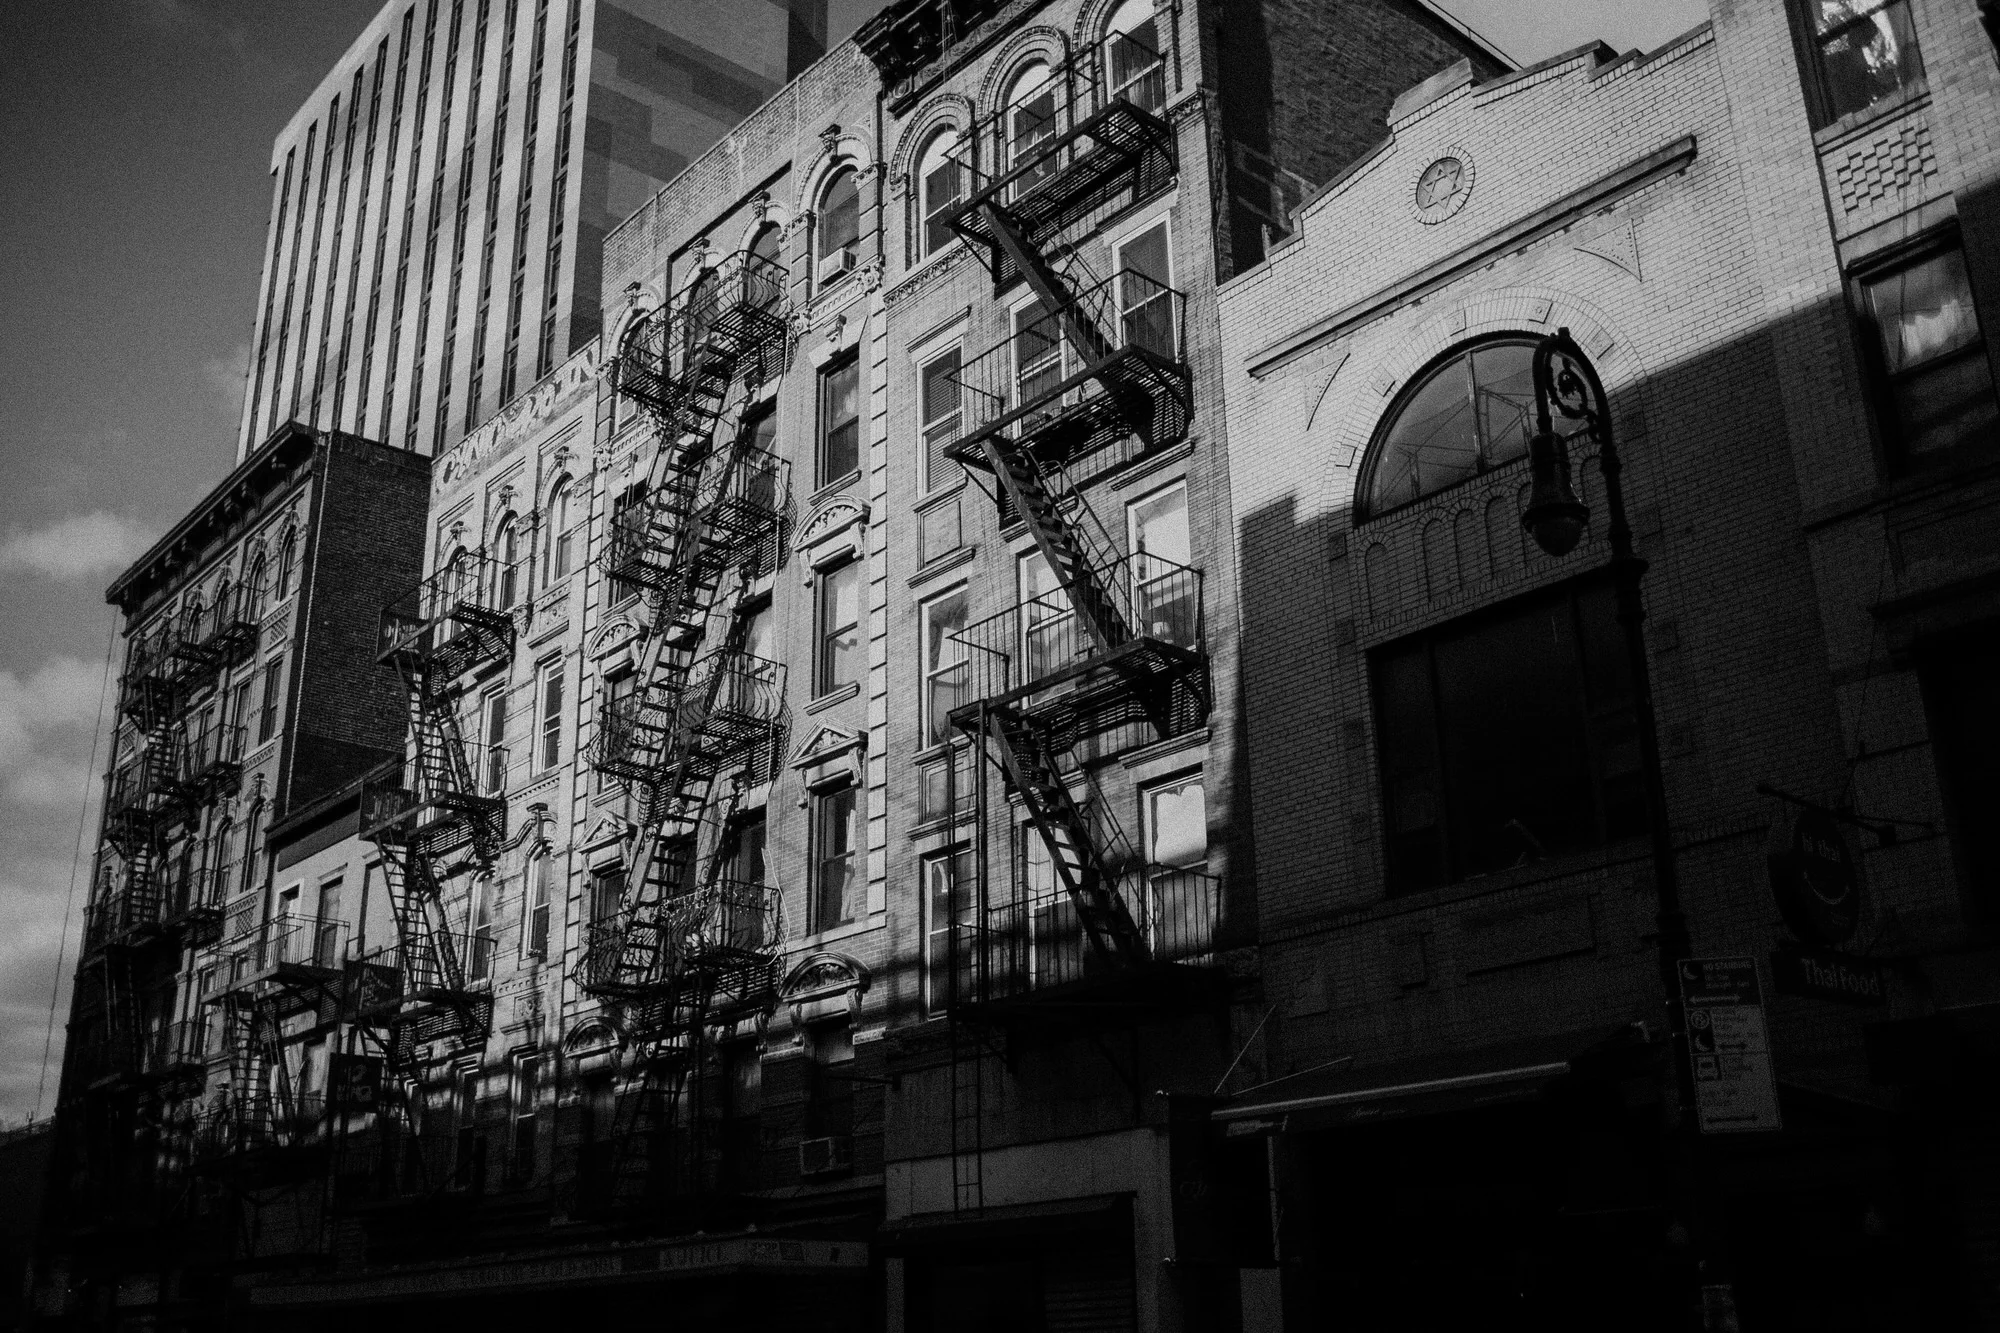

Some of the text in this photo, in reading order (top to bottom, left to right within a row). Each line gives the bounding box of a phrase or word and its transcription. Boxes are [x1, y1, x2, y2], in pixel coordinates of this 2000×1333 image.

[1702, 962, 1714, 972] NO
[1800, 956, 1881, 997] Thai Food
